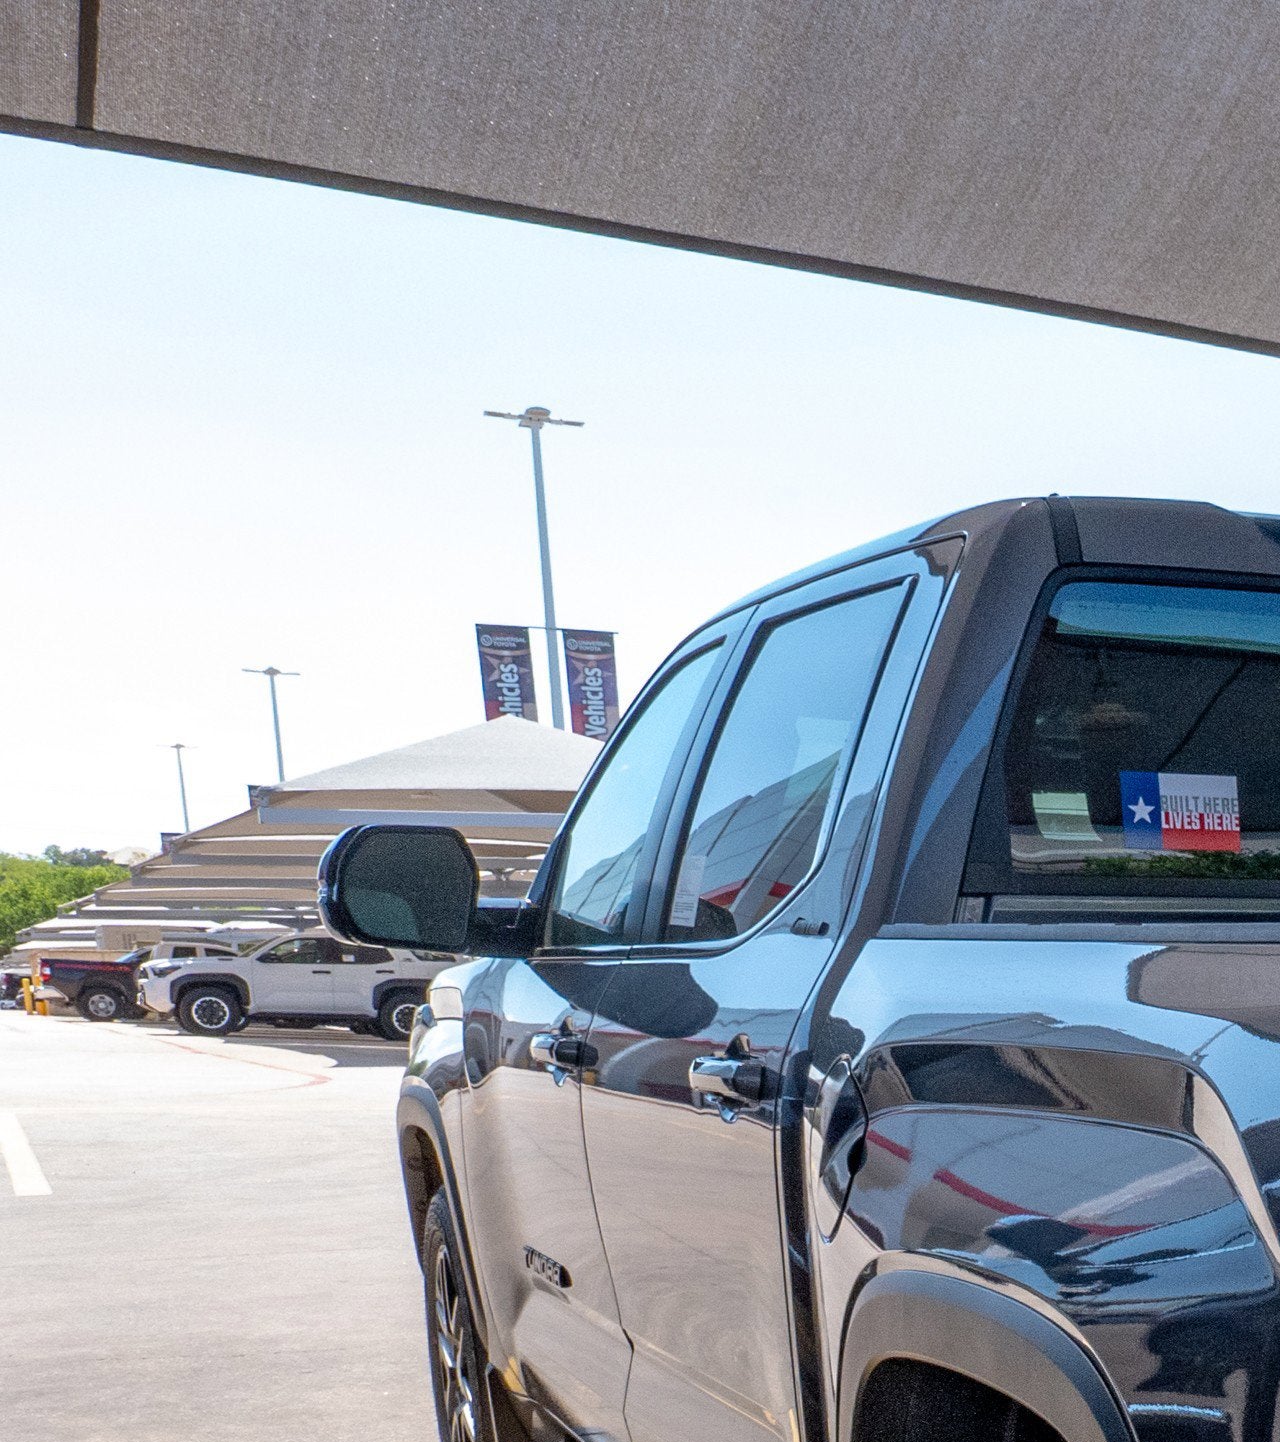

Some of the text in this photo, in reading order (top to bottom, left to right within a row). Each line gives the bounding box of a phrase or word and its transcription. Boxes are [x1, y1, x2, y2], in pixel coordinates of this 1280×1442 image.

[496, 662, 523, 718] hicles
[581, 666, 608, 737] Vehicles
[1161, 795, 1239, 815] BUILT HERE
[1161, 811, 1240, 831] LIVES HERE
[523, 1245, 562, 1288] TUNDRA
